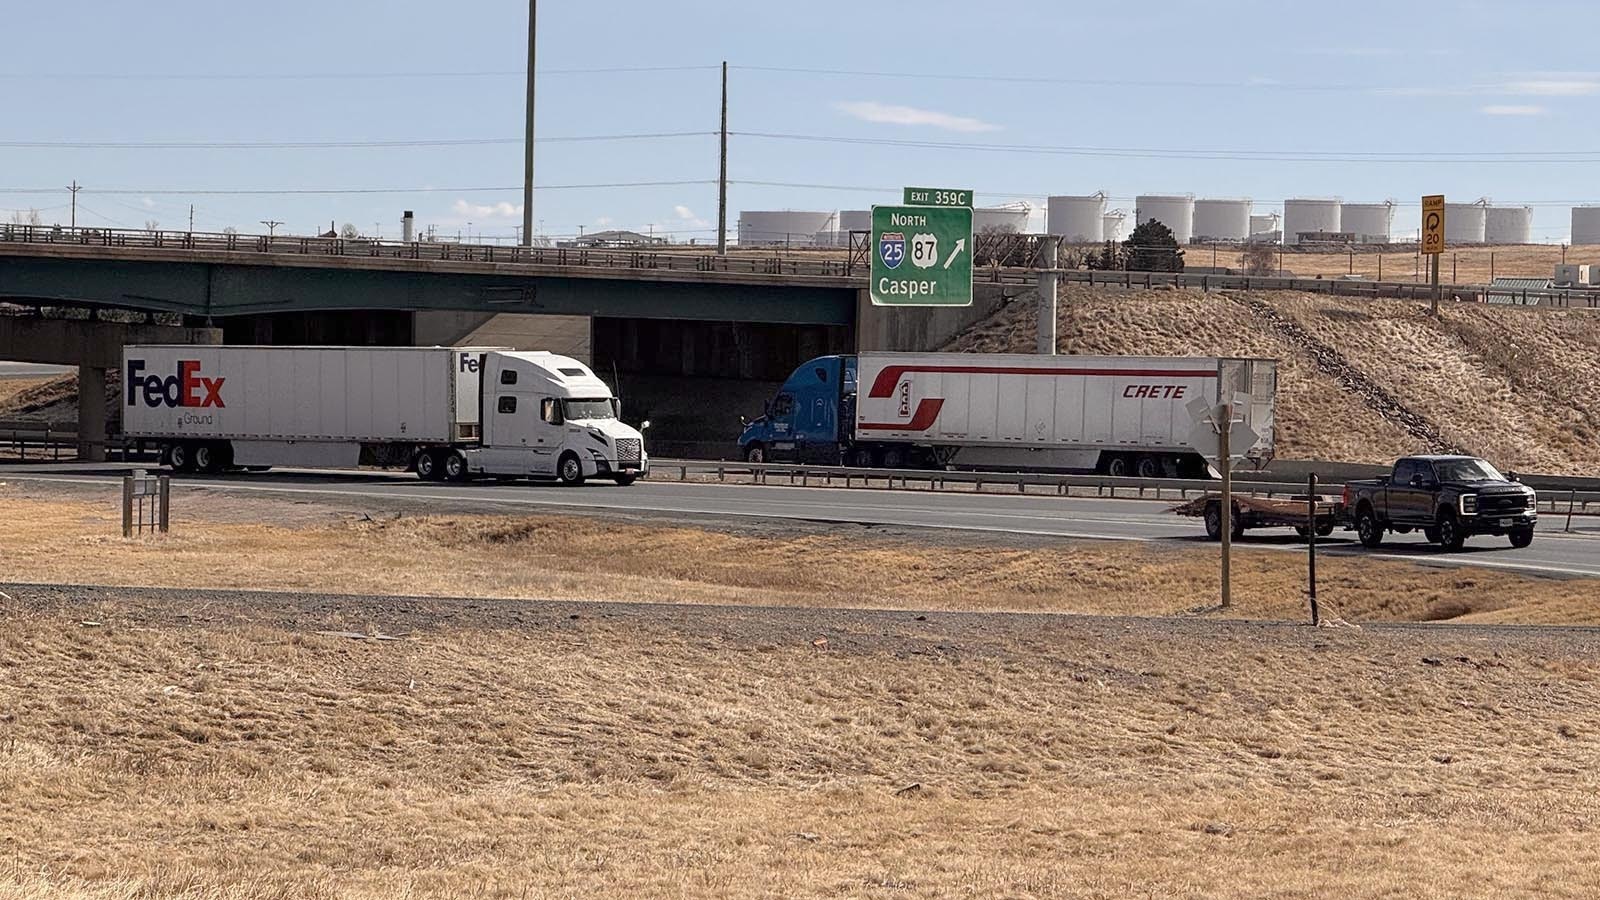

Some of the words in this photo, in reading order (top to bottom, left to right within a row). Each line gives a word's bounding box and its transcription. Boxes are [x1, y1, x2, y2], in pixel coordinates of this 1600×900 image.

[911, 192, 929, 202] EXIT
[935, 191, 966, 205] 359C
[891, 213, 926, 226] NORTH
[1426, 233, 1440, 245] 20
[884, 243, 903, 261] 25
[914, 241, 935, 260] 87
[879, 277, 937, 299] Casper
[460, 352, 480, 373] Fe
[127, 359, 226, 409] FedEx
[1123, 384, 1188, 399] CRETE
[183, 411, 213, 425] Ground
